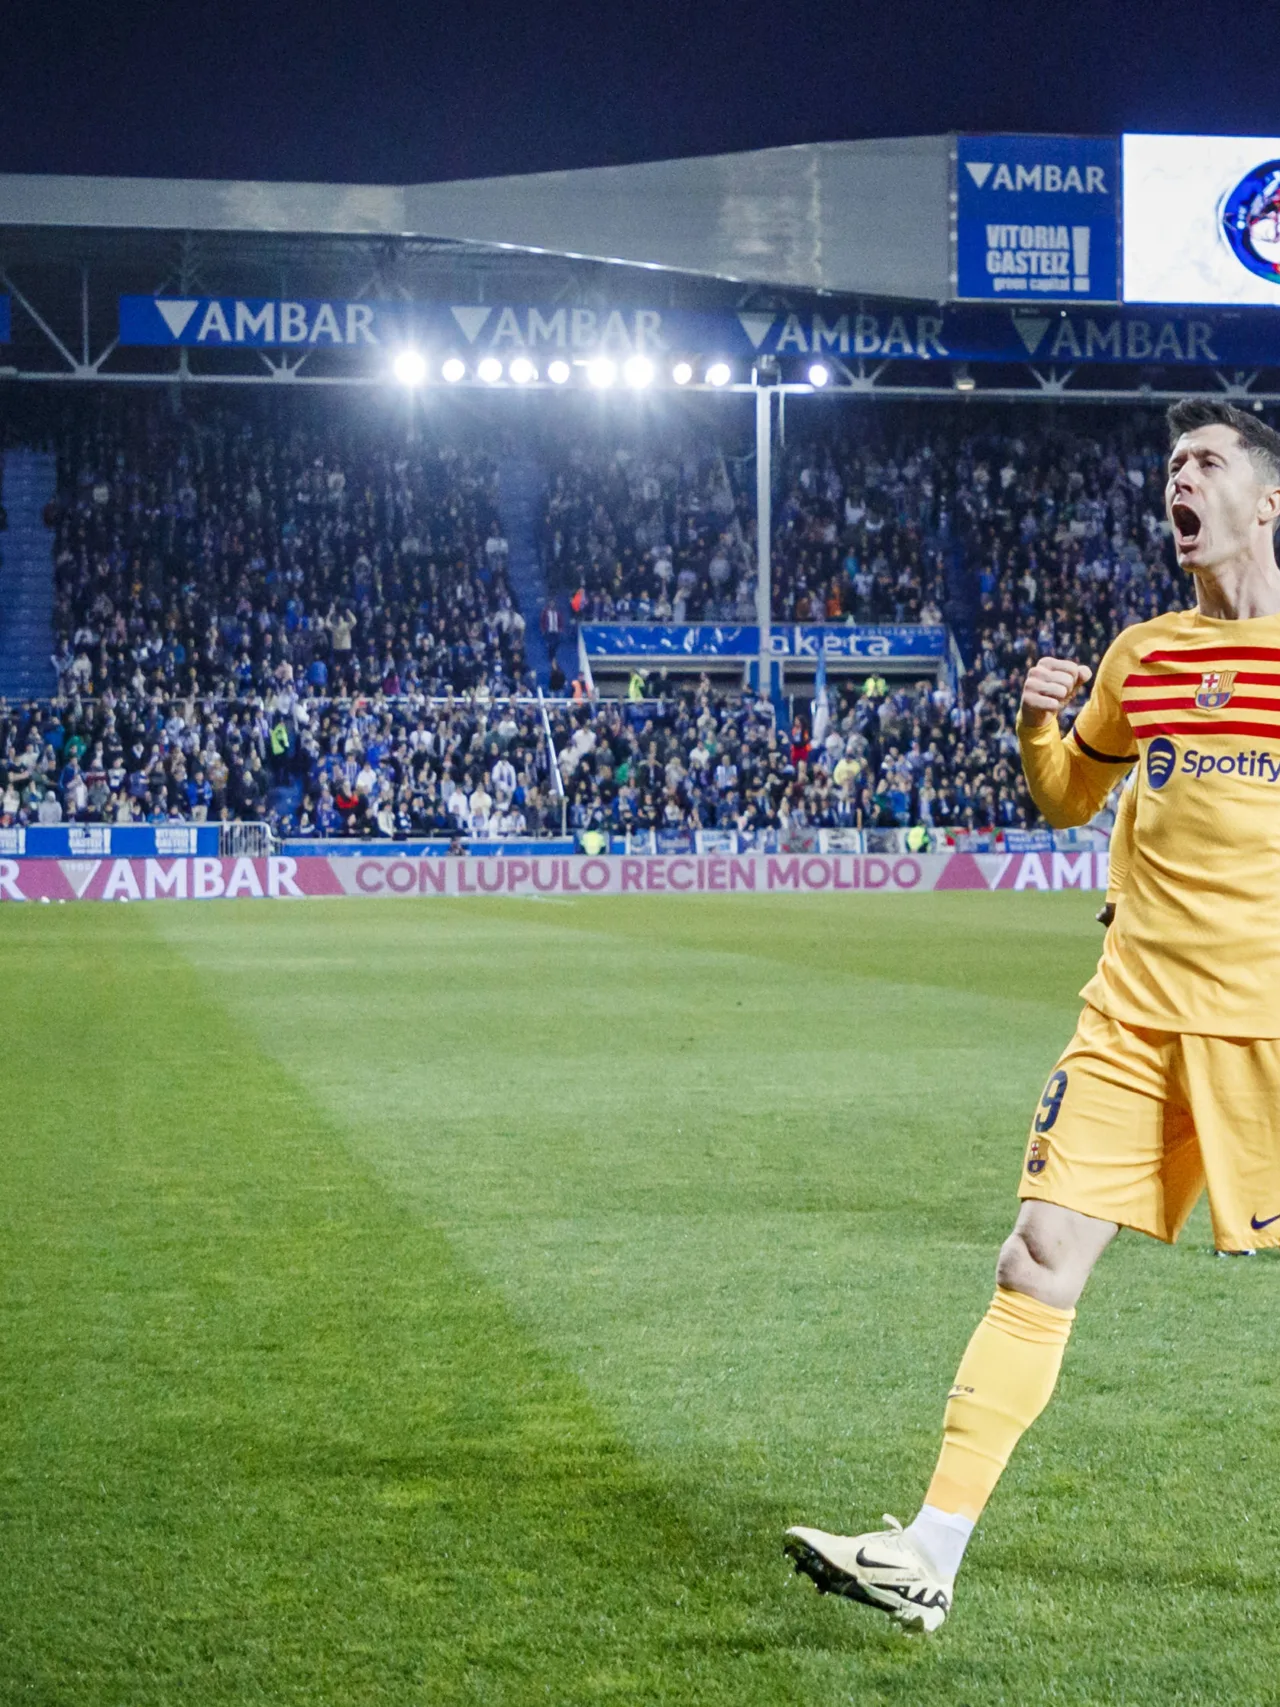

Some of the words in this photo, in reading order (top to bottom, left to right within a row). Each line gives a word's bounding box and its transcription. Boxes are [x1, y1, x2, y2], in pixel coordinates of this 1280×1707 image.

[993, 164, 1107, 194] AMBAR
[986, 224, 1070, 250] VITORIA
[986, 249, 1070, 276] GASTEIZ
[196, 301, 379, 345] AMBAR
[491, 309, 664, 352] AMBAR
[774, 314, 950, 357] AMBAR
[1050, 320, 1219, 362] AMBAR
[102, 856, 303, 899] AMBAR
[355, 860, 447, 893] CON
[767, 857, 922, 890] MOLIDO
[1034, 1069, 1068, 1133] 9
